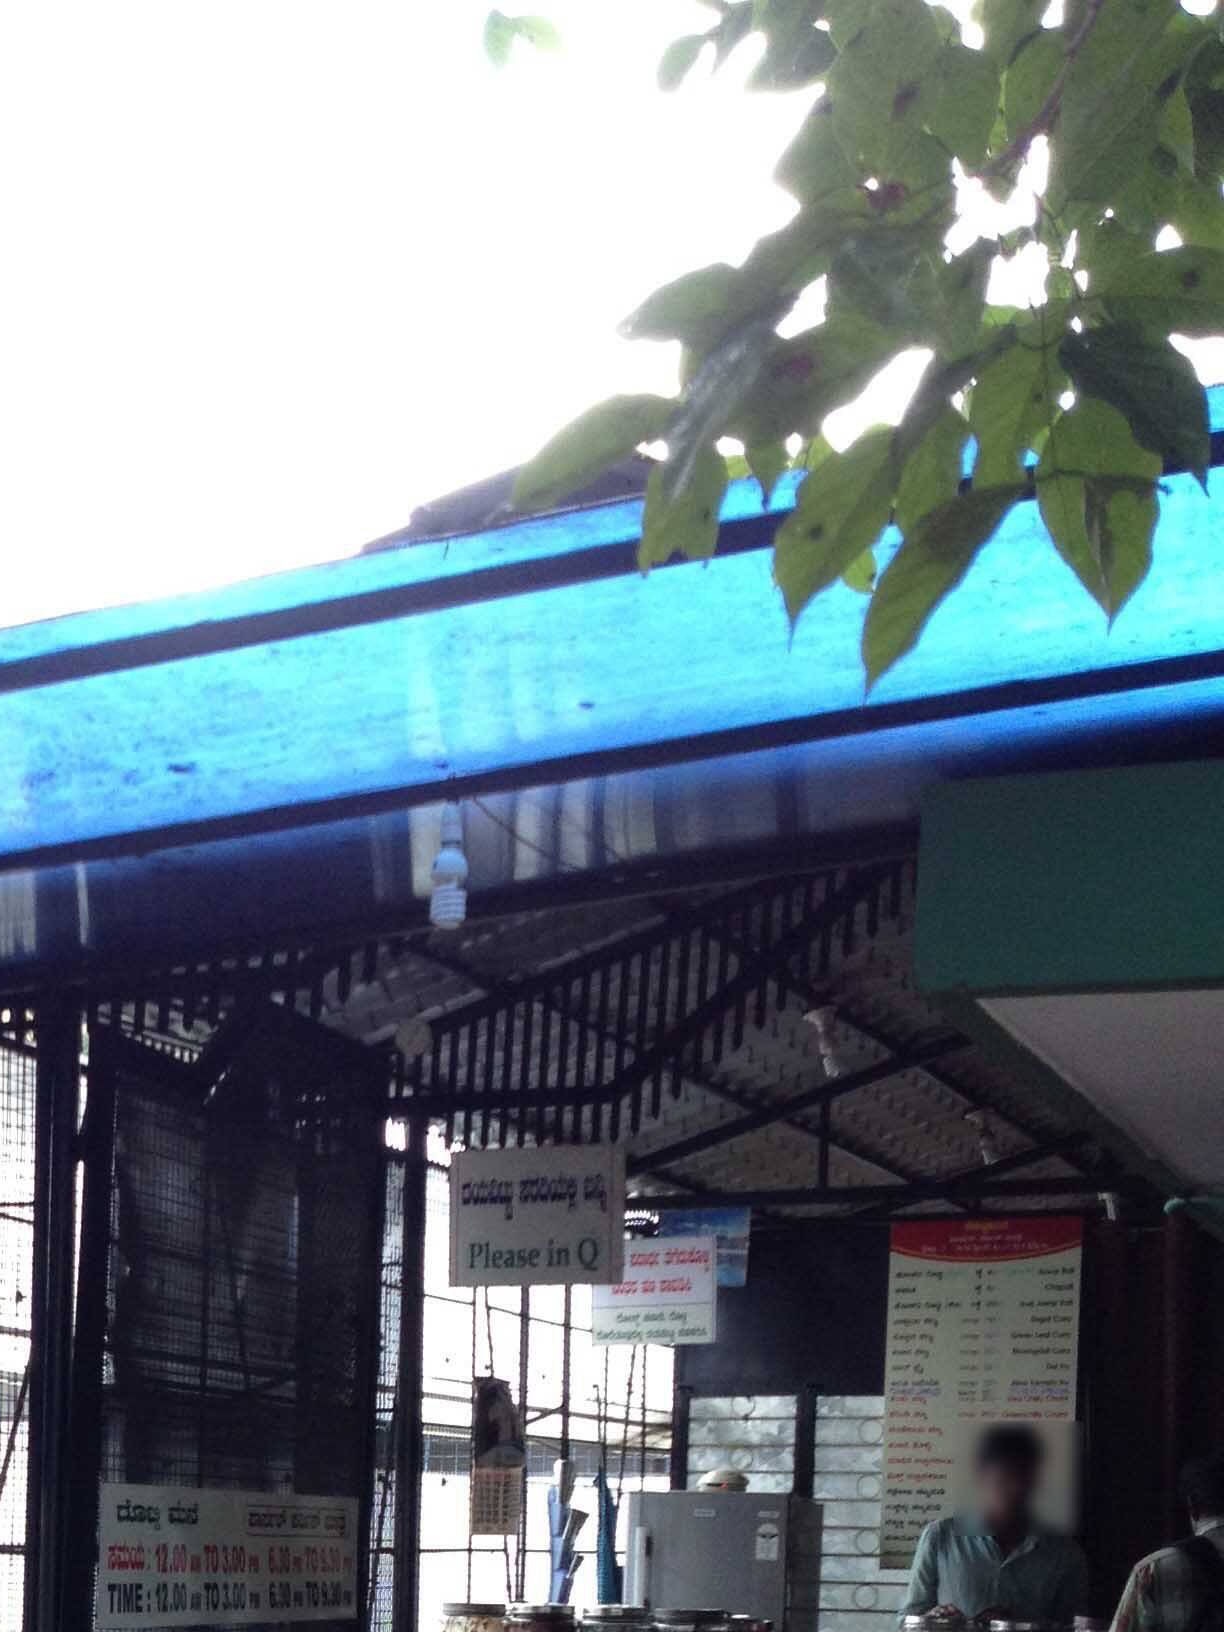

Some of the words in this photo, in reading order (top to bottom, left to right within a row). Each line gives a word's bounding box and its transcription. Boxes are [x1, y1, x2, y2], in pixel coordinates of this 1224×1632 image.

[469, 1241, 540, 1270] Please
[547, 1239, 570, 1268] in
[577, 1237, 600, 1271] Q
[108, 1583, 143, 1613] TIME
[155, 1582, 187, 1612] 12.00
[204, 1582, 219, 1611] TO
